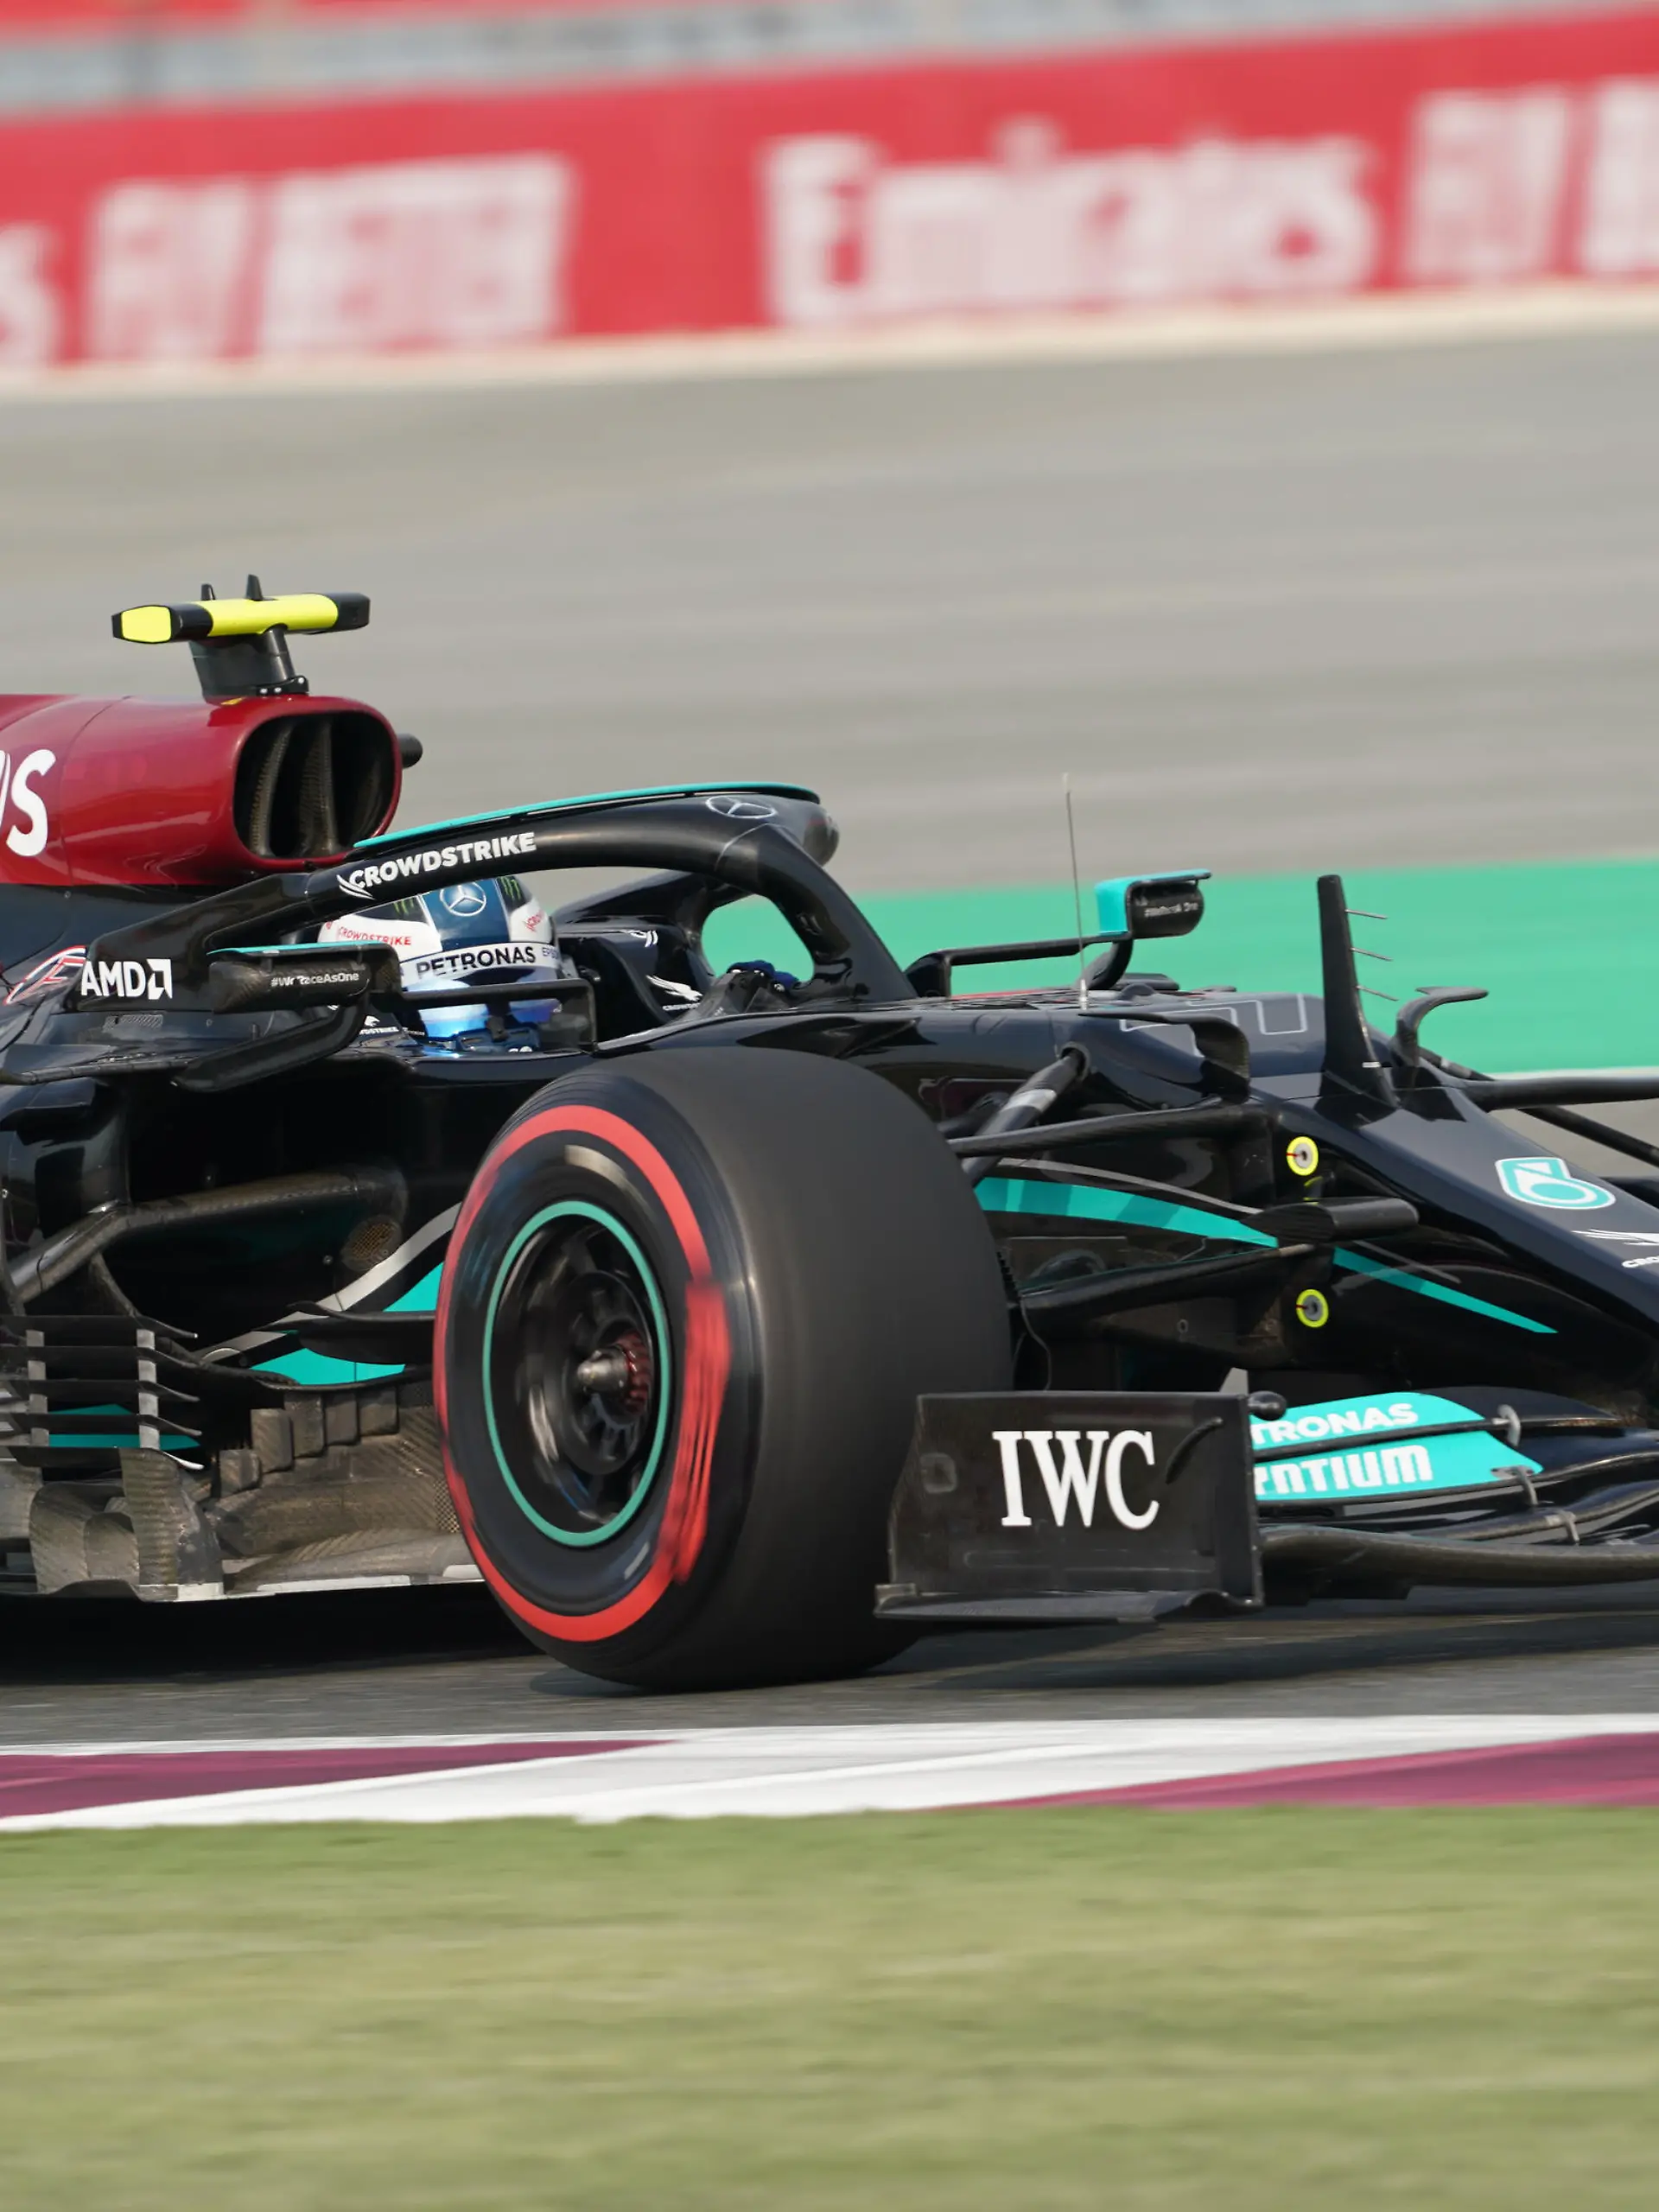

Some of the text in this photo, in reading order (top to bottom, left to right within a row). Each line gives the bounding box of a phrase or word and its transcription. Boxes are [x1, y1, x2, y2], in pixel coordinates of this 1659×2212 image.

[0, 749, 56, 856] S
[348, 832, 537, 891] CROWDSTRIKE
[80, 961, 147, 997] AMD
[416, 946, 537, 978] PETRONAS
[1250, 1403, 1419, 1445] TRONAS
[992, 1430, 1160, 1529] IWC
